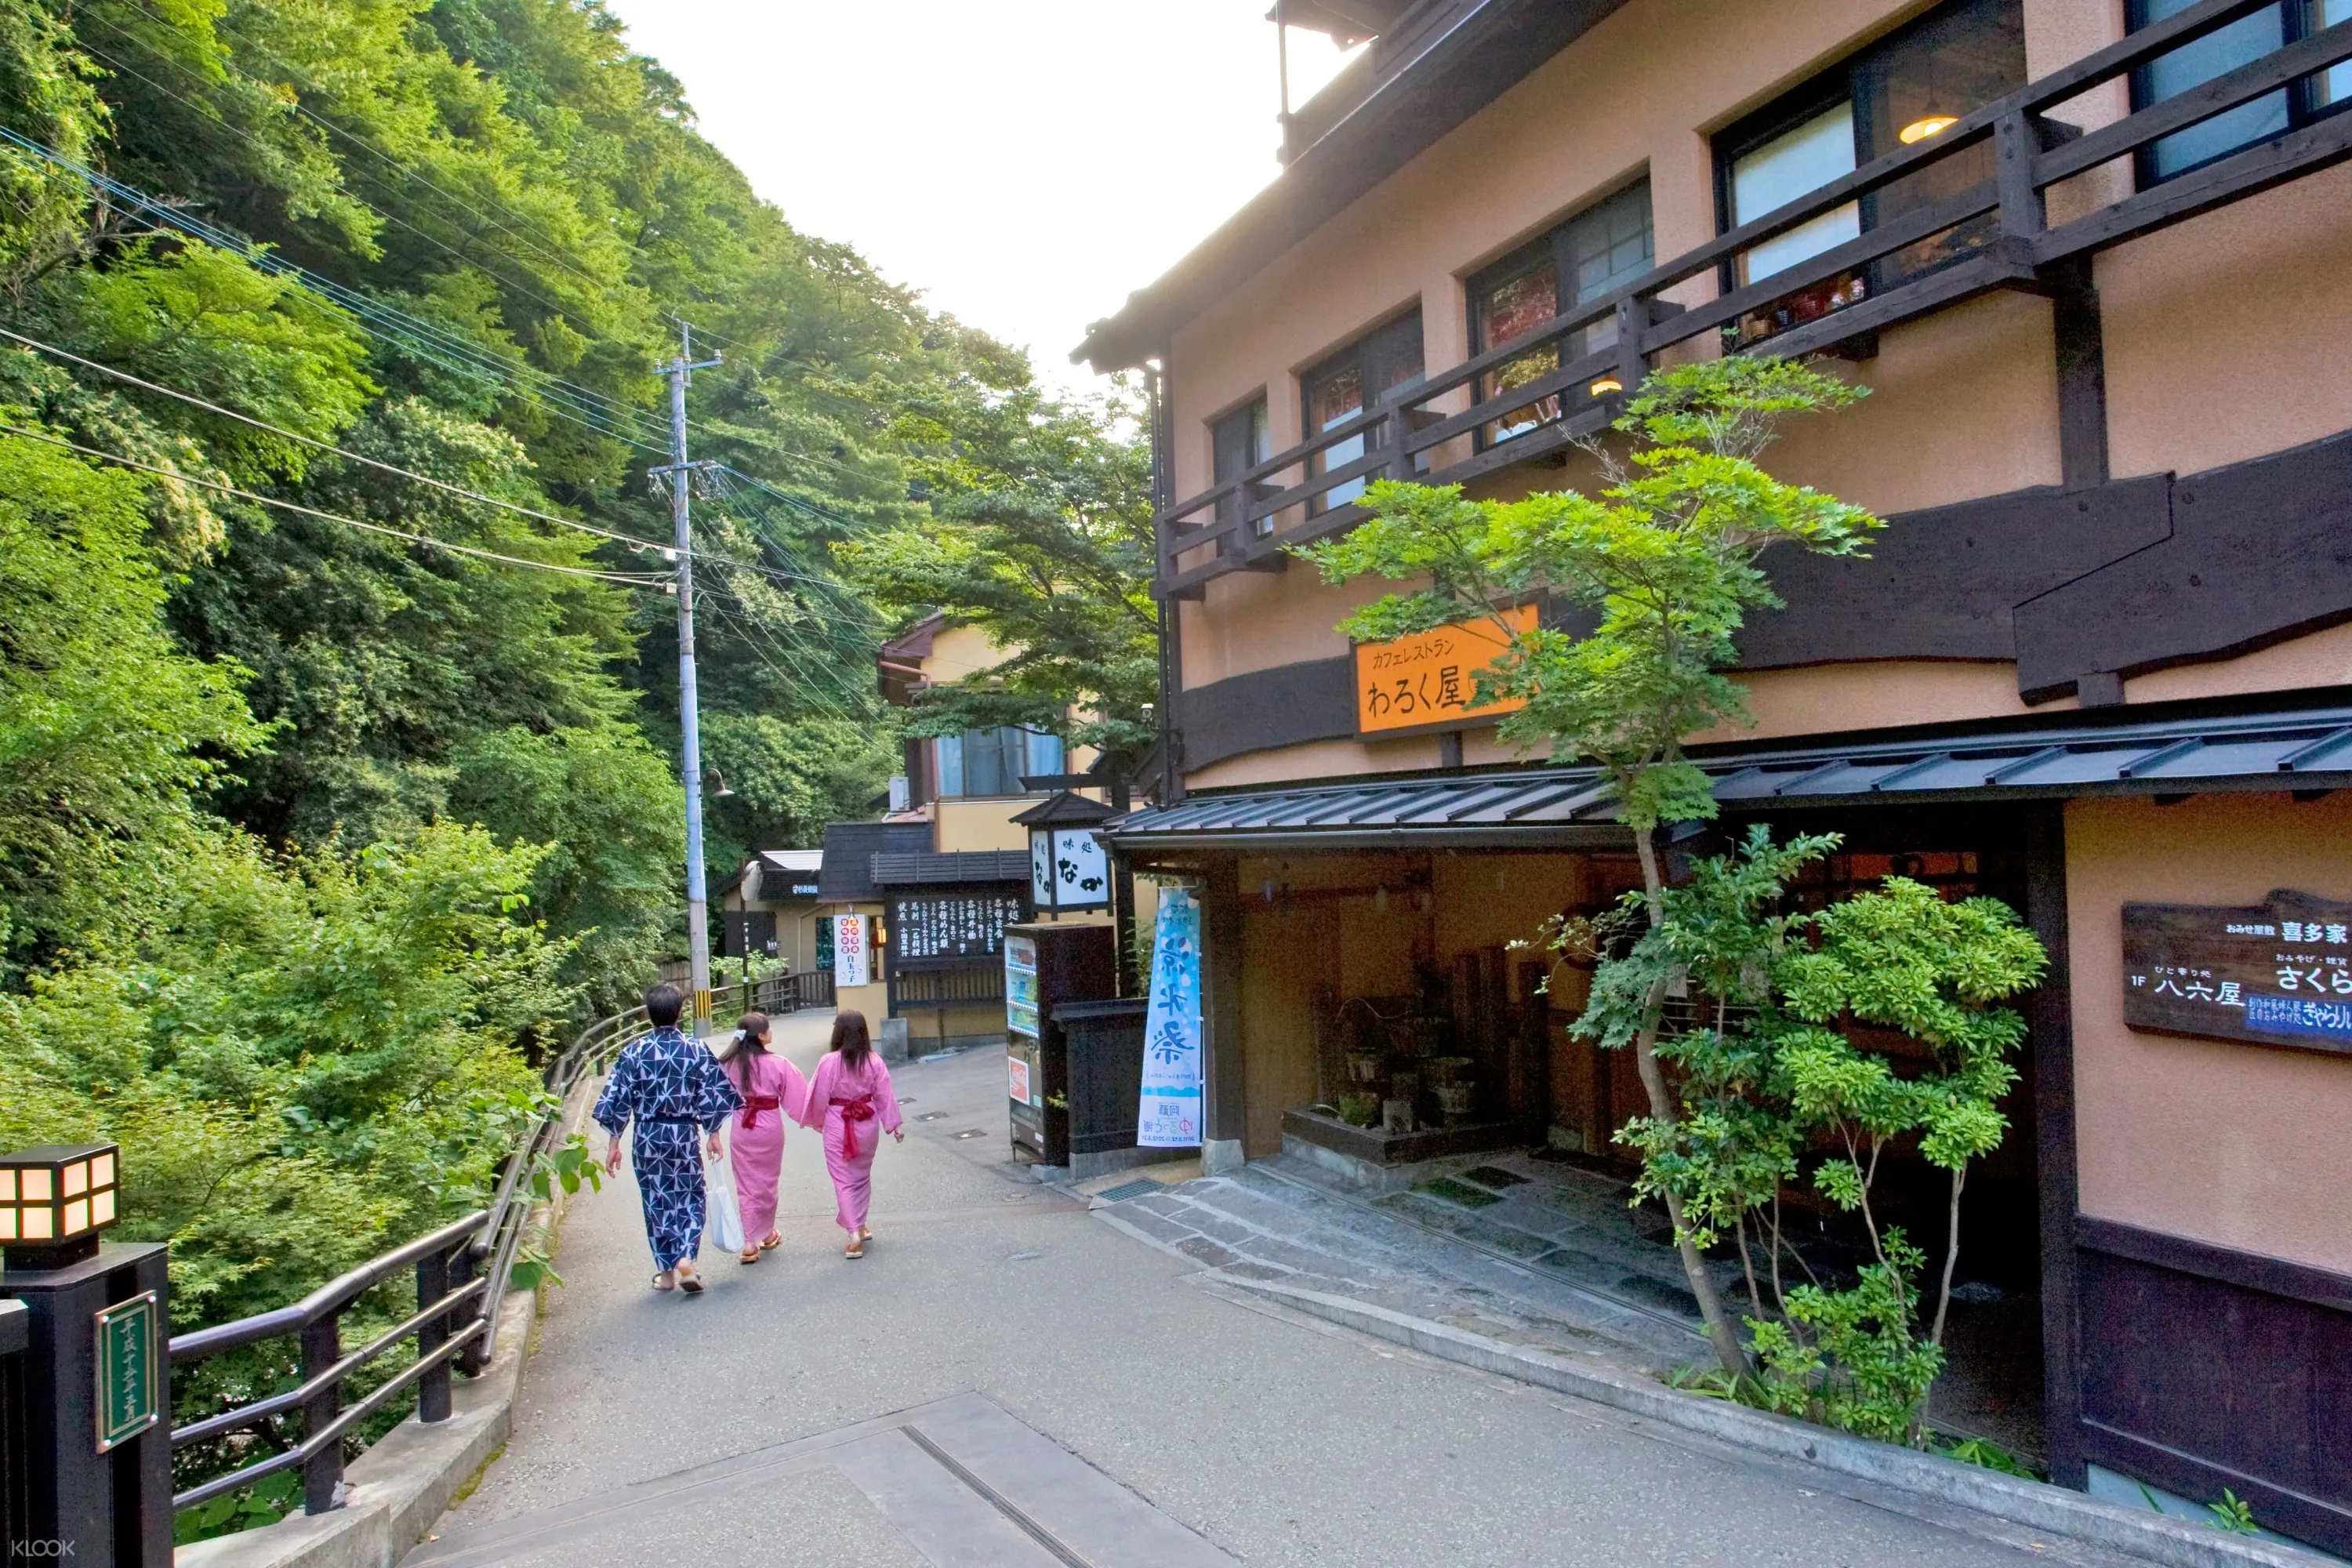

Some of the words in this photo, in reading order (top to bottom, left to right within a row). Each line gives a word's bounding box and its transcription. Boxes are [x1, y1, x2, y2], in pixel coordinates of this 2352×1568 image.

[1373, 638, 1454, 670] カフェレストラン
[1368, 666, 1465, 717] わろく屋
[1062, 837, 1092, 853] 味処
[1058, 857, 1104, 891] なか
[994, 898, 1004, 938] 各種定食
[2131, 975, 2146, 986] 1F
[2154, 980, 2246, 1007] 八六屋
